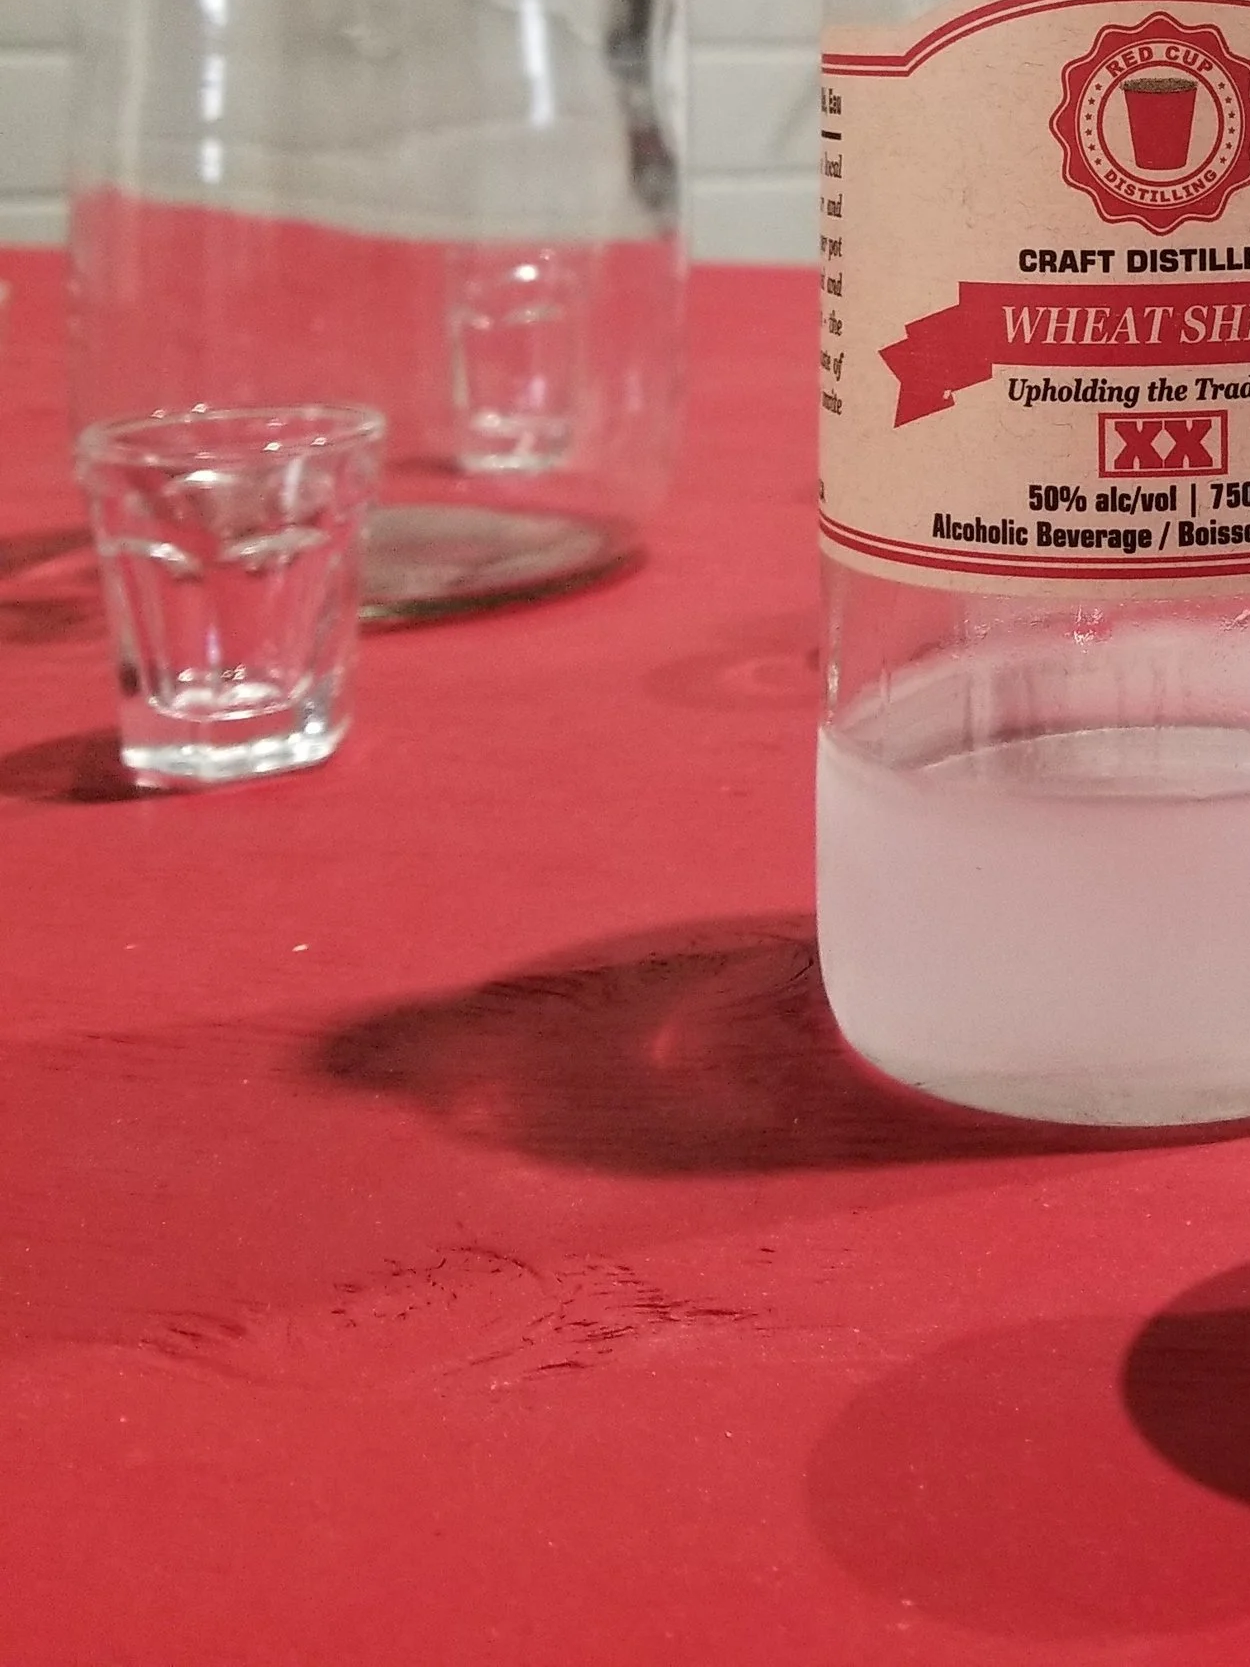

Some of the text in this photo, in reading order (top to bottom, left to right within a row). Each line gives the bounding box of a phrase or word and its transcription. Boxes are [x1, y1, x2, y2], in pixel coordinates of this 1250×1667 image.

[1105, 45, 1214, 78] RED CUP
[1103, 168, 1217, 203] DISTILLING
[1018, 248, 1115, 273] CRAFT
[1002, 305, 1174, 345] WHEAT
[1008, 378, 1141, 409] Upholding
[1147, 378, 1188, 403] the
[1113, 419, 1213, 470] XX
[1028, 484, 1087, 513] 50%
[1095, 484, 1177, 513] alc/vol
[932, 512, 1029, 547] Alcoholic
[1036, 520, 1153, 550] Beverage
